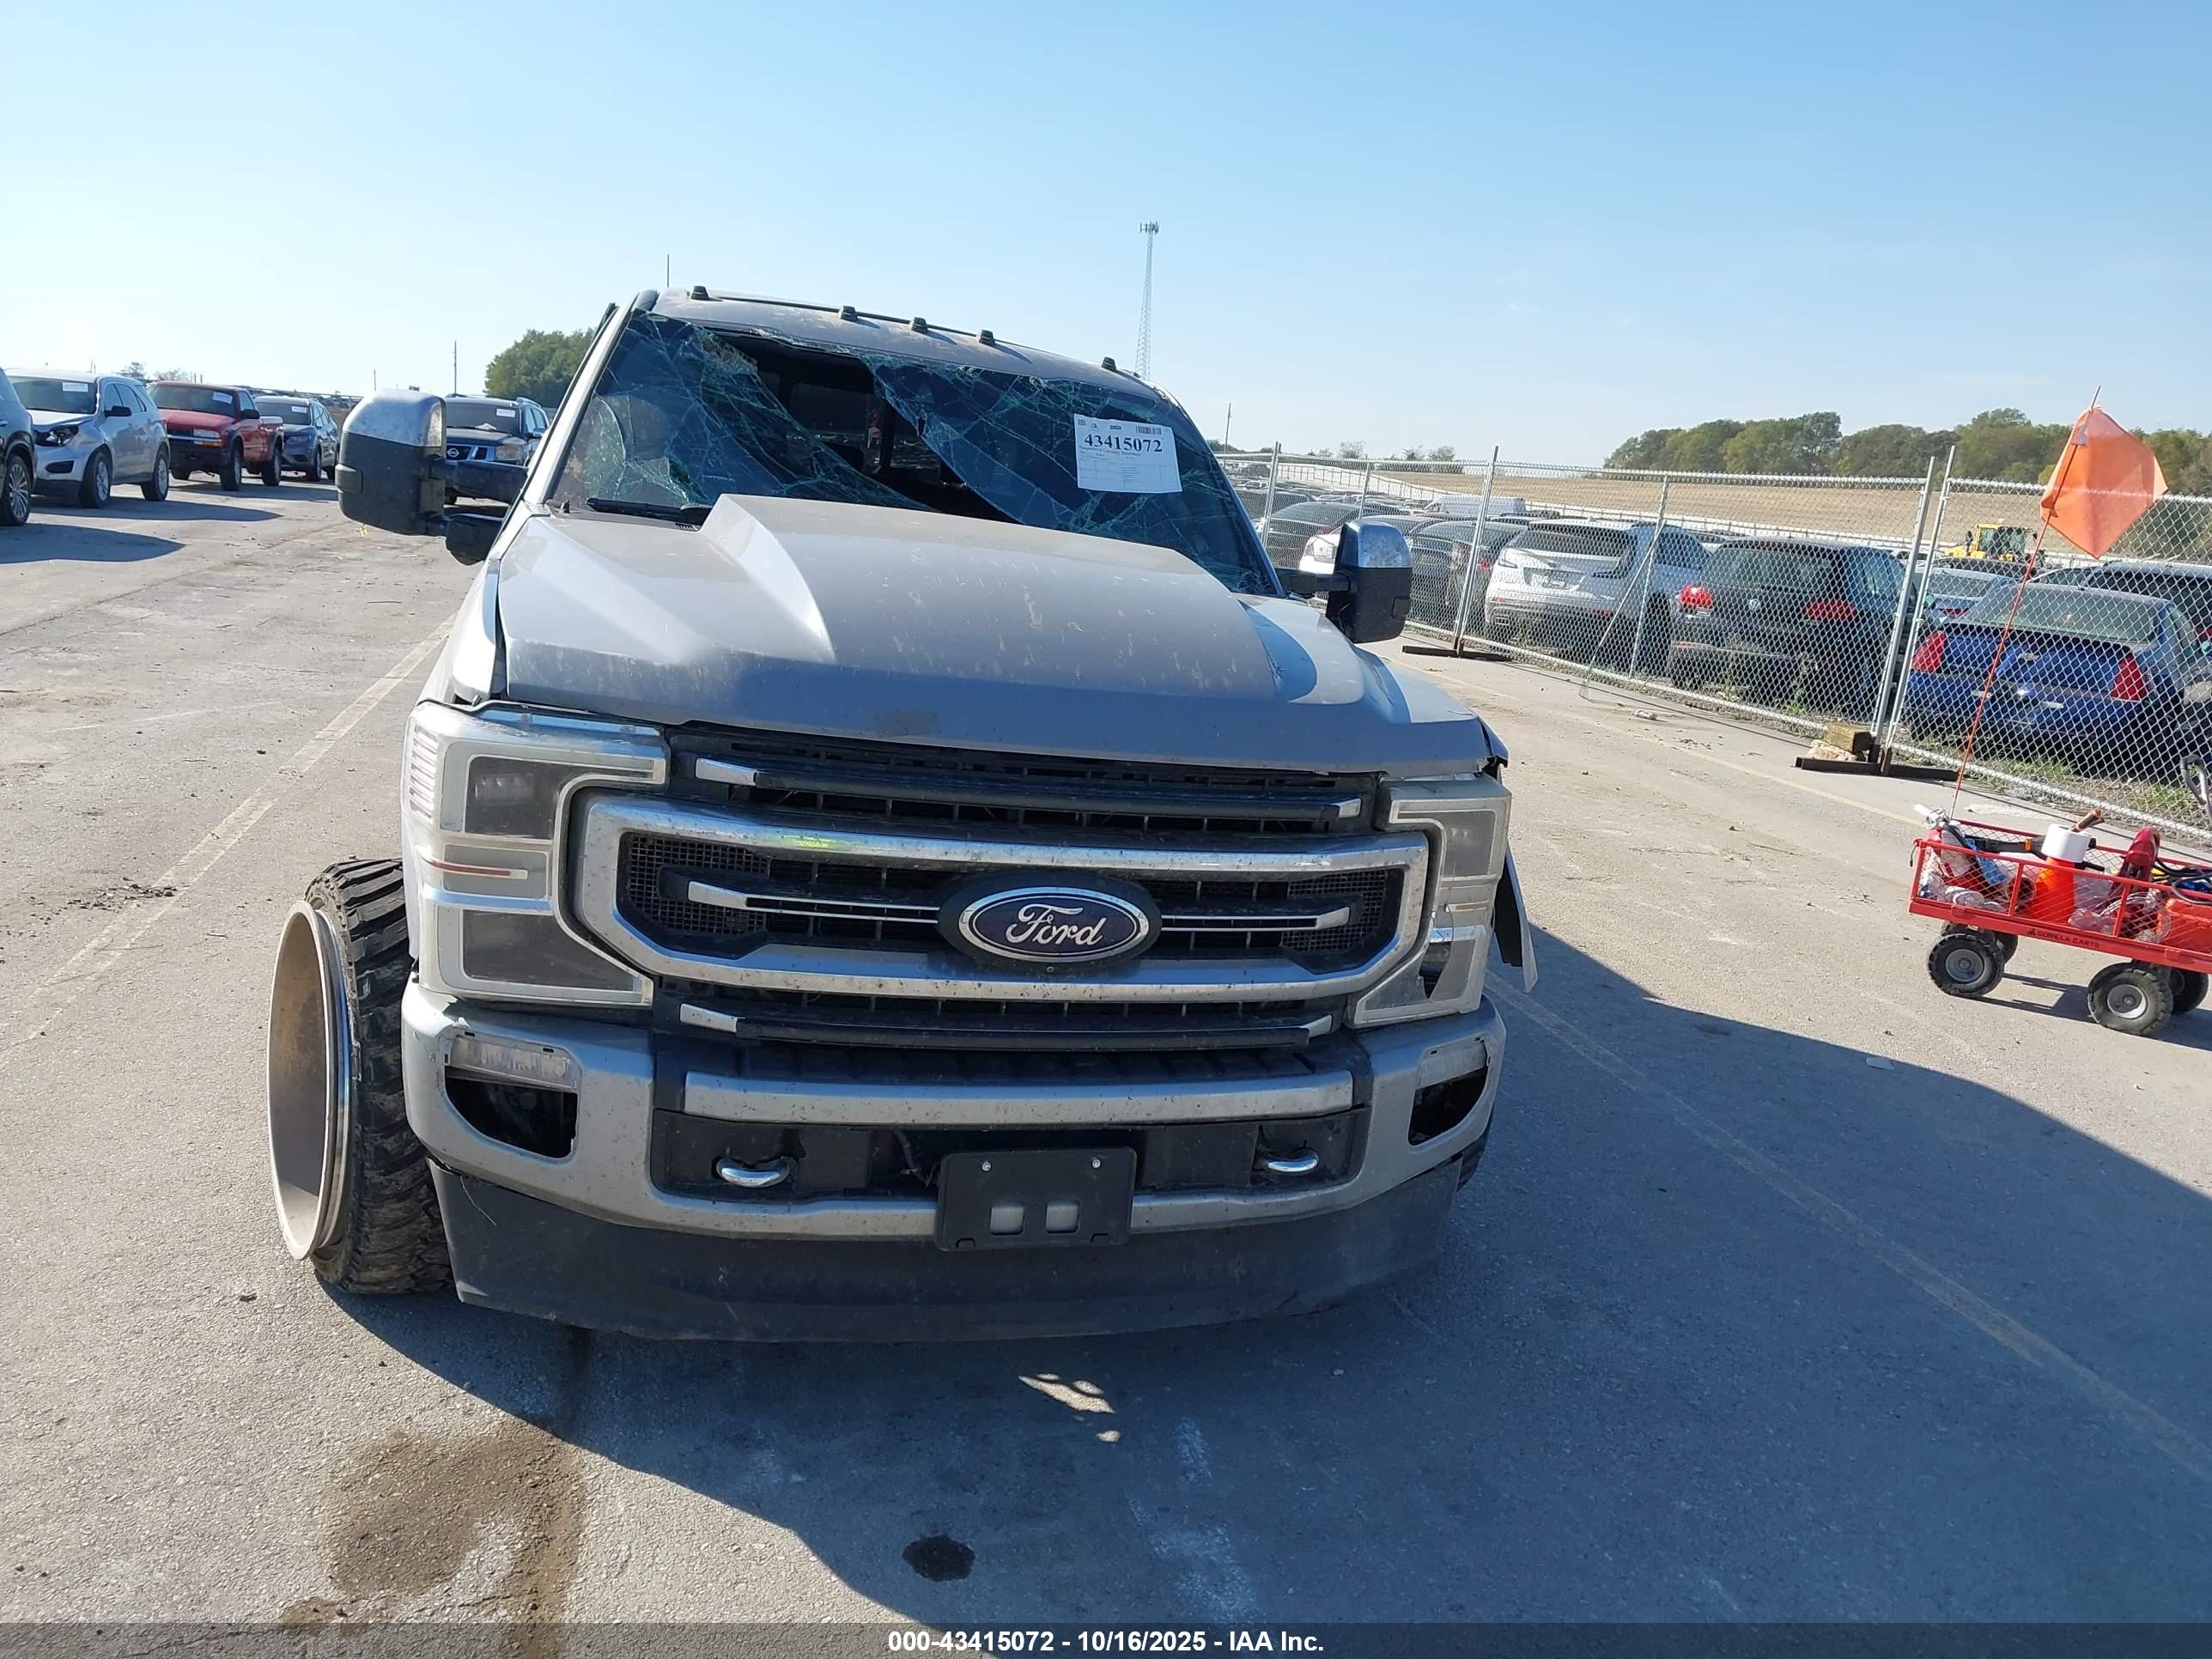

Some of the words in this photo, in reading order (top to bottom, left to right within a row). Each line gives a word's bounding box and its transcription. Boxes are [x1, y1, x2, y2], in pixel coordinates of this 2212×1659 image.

[1085, 434, 1163, 453] 43415072
[1006, 903, 1107, 945] Ford
[2037, 931, 2070, 943] GORILLA
[2072, 938, 2100, 948] CARTS
